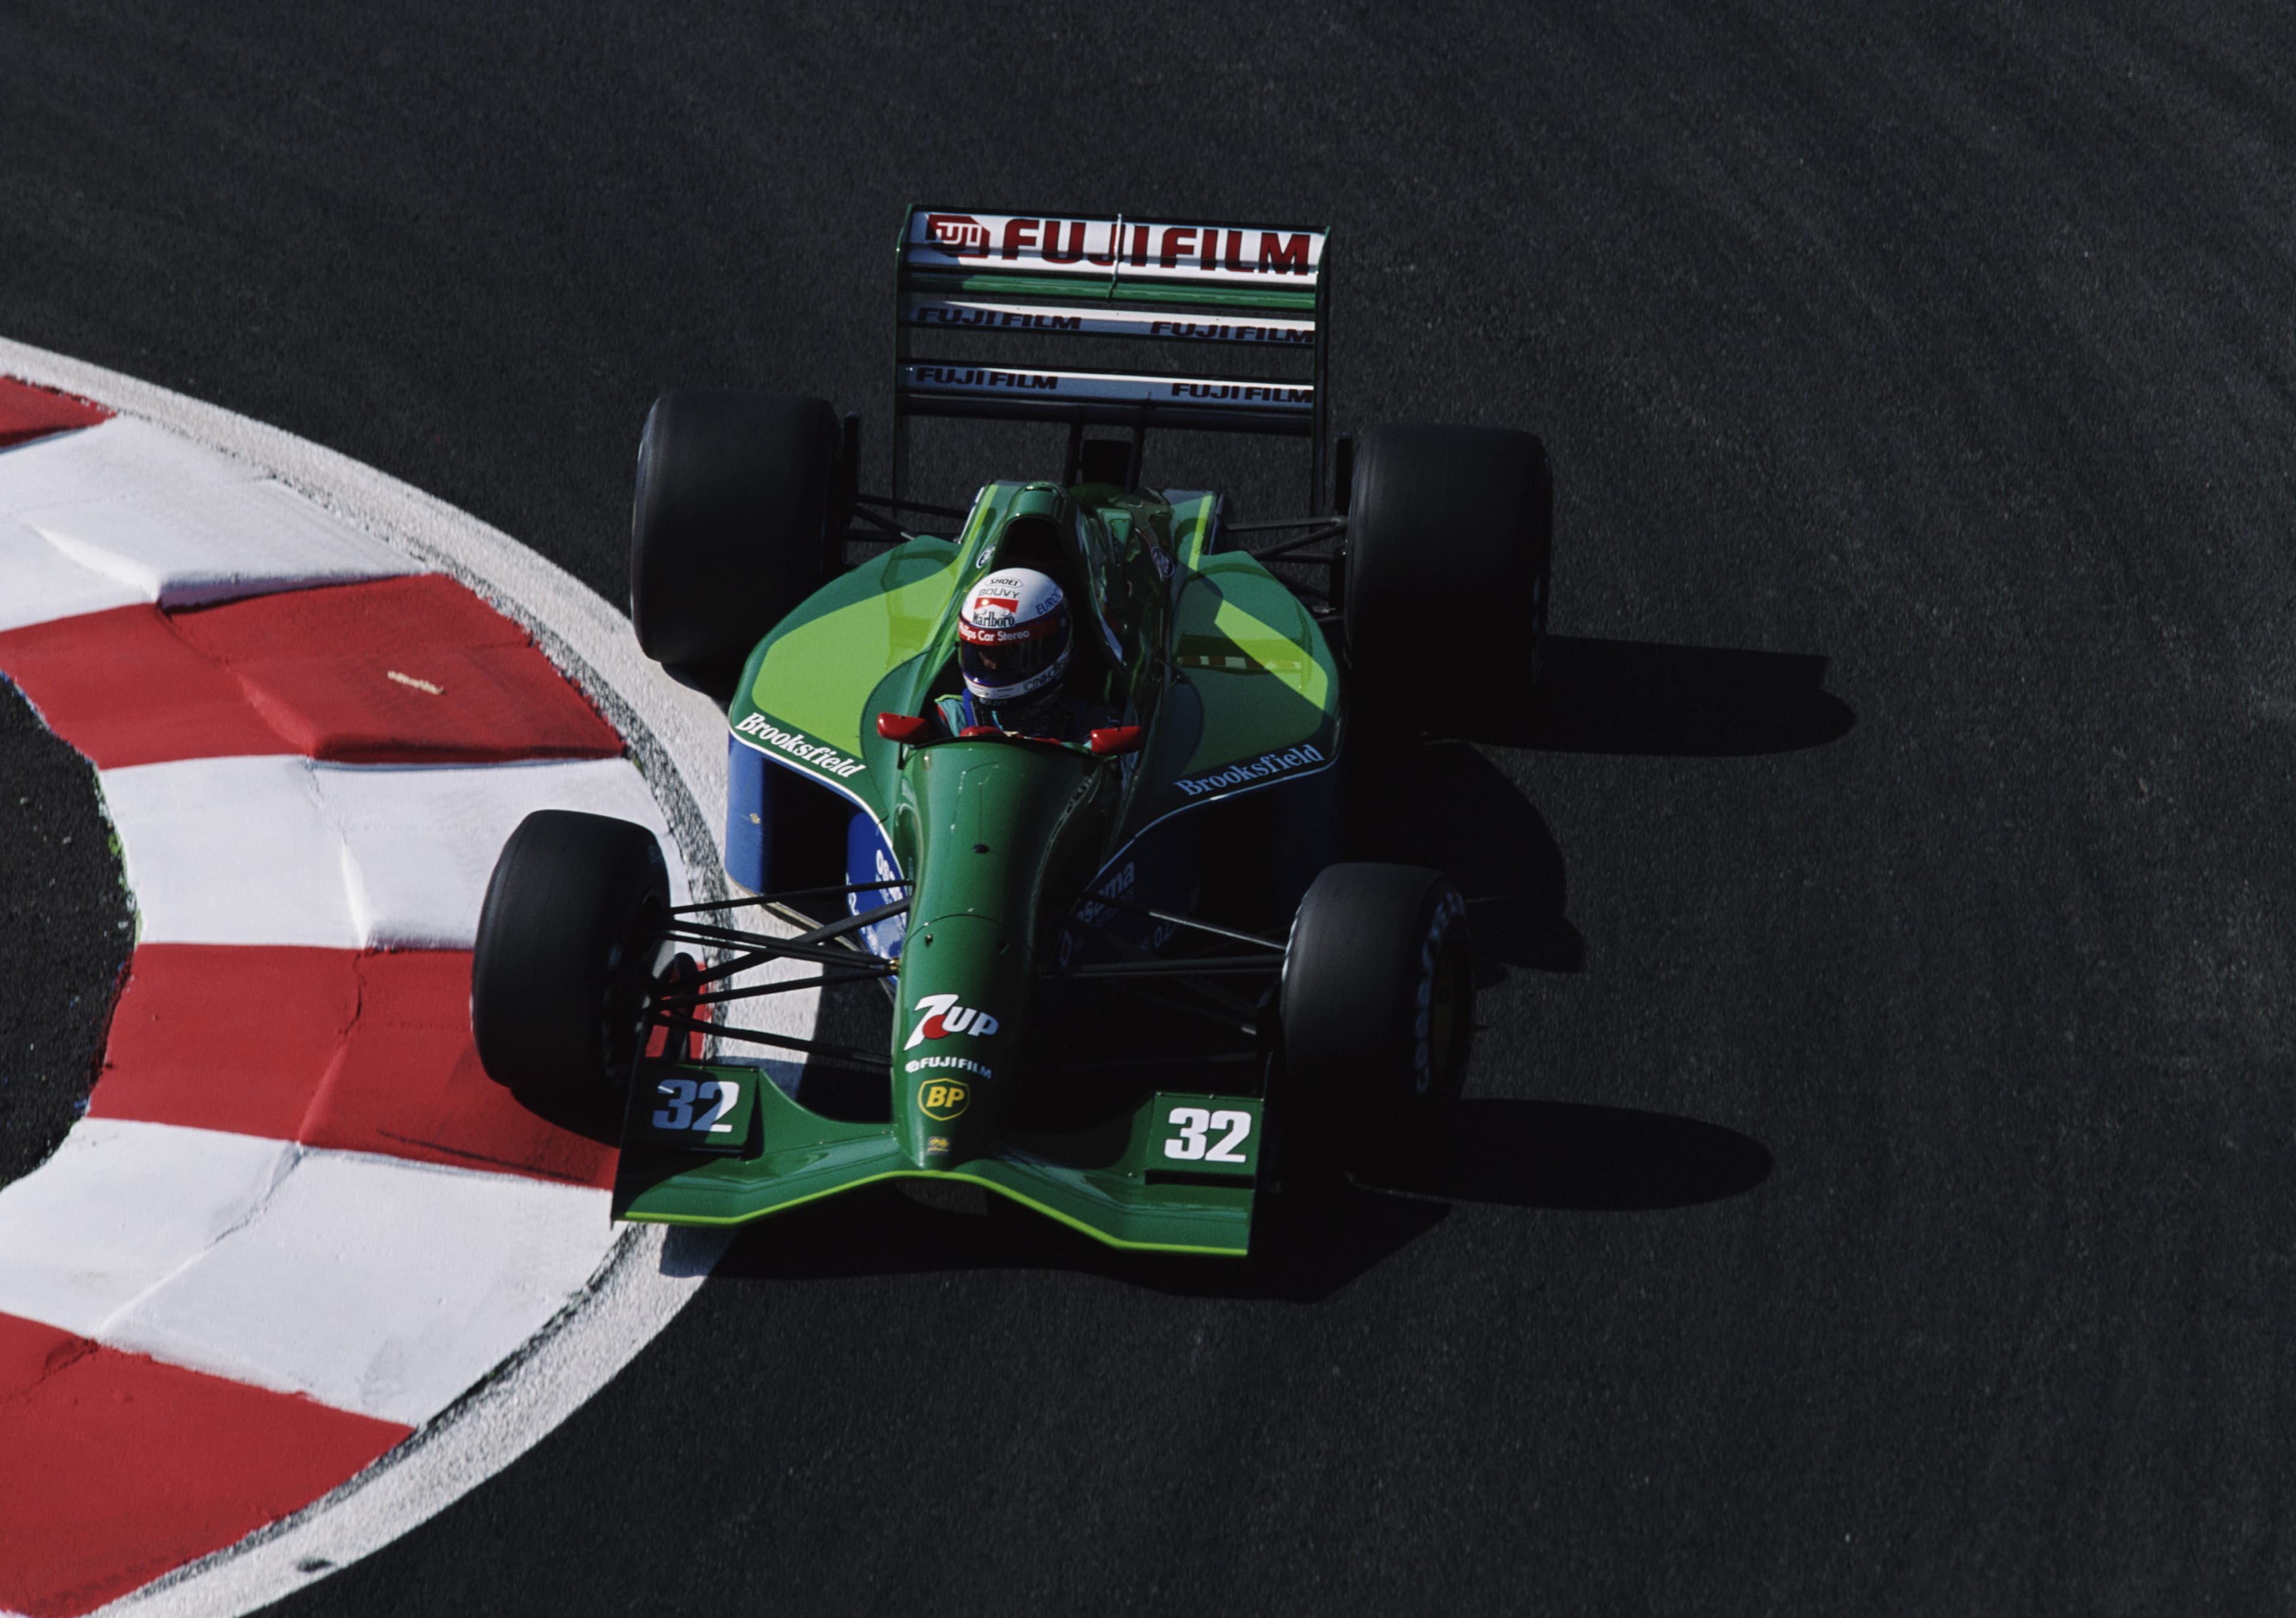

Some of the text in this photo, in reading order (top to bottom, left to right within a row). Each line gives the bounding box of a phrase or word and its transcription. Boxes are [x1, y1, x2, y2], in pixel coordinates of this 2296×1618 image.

[1002, 218, 1311, 276] FUJIFILM
[917, 307, 1082, 330] FUJIFILM
[1150, 321, 1315, 343] FUJIFILM
[915, 367, 1058, 390] FUJIFILM
[1171, 383, 1314, 404] FUJIFILM
[978, 587, 1019, 599] BOUVY
[990, 578, 1019, 587] SHOEI
[973, 610, 1015, 627] Marlboro
[978, 630, 996, 642] Car
[997, 630, 1030, 642] Stereo
[735, 712, 866, 778] Brooksfield
[1172, 743, 1325, 796] Brooksfield
[918, 1055, 993, 1079] FUJIFILM
[651, 1079, 740, 1133] 32
[926, 1086, 964, 1107] BP
[1164, 1107, 1252, 1163] 32
